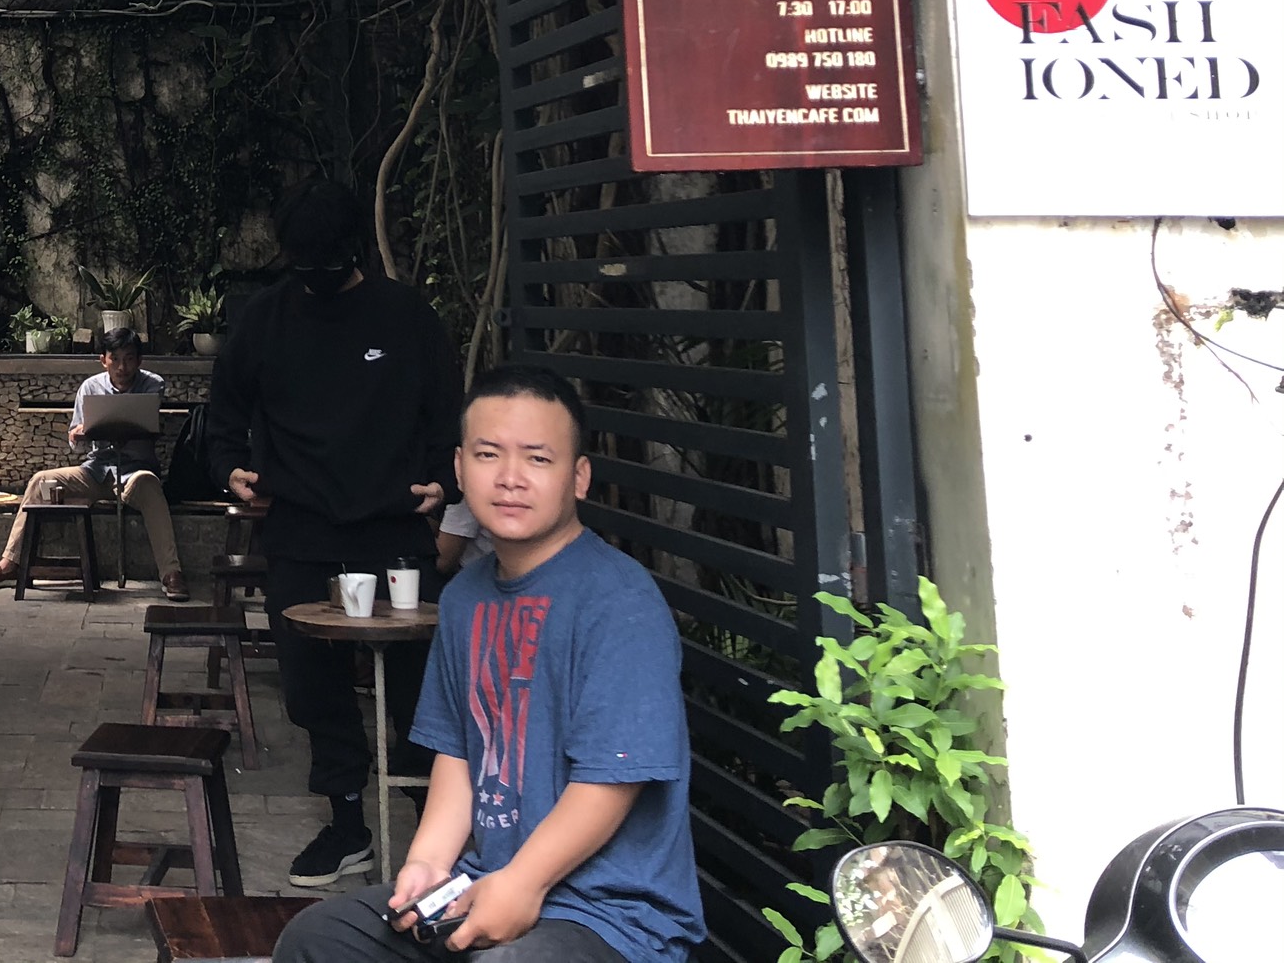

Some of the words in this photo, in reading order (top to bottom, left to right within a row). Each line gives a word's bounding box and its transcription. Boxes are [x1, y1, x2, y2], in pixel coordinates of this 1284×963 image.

[804, 27, 873, 44] HOTLINE
[766, 52, 808, 68] 0989
[812, 51, 843, 67] 750
[847, 51, 876, 66] 180
[1020, 57, 1260, 100] IONED
[806, 84, 878, 100] WEBSITE
